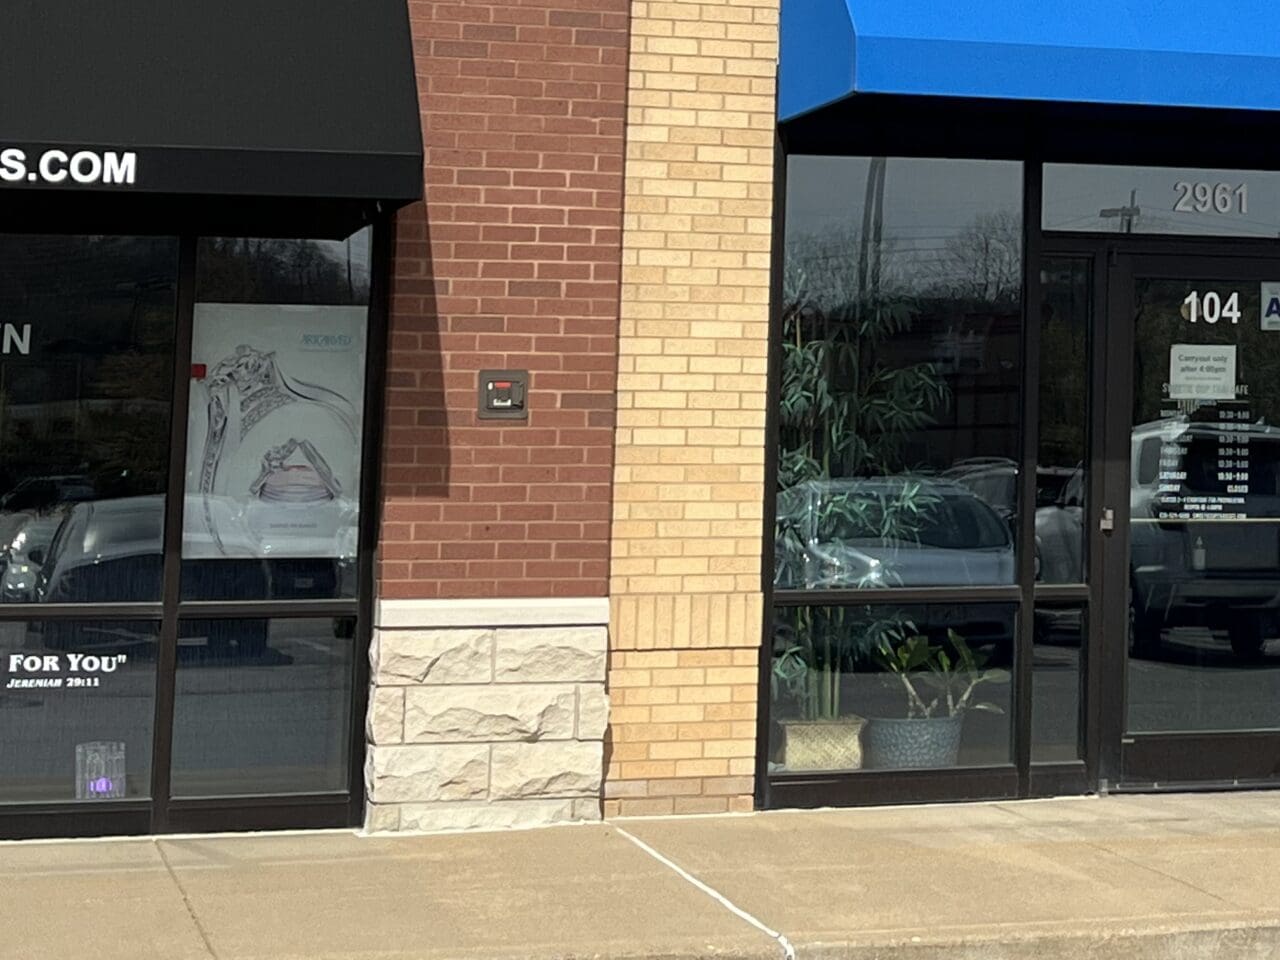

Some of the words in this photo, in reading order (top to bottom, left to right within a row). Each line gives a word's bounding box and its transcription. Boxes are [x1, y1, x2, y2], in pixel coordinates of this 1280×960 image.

[0, 148, 137, 184] S.COM
[1173, 181, 1248, 214] 2961
[1184, 291, 1242, 324] 104
[0, 323, 31, 355] N
[9, 654, 60, 672] FOR
[66, 653, 127, 672] YOU"
[66, 677, 99, 687] 29:11
